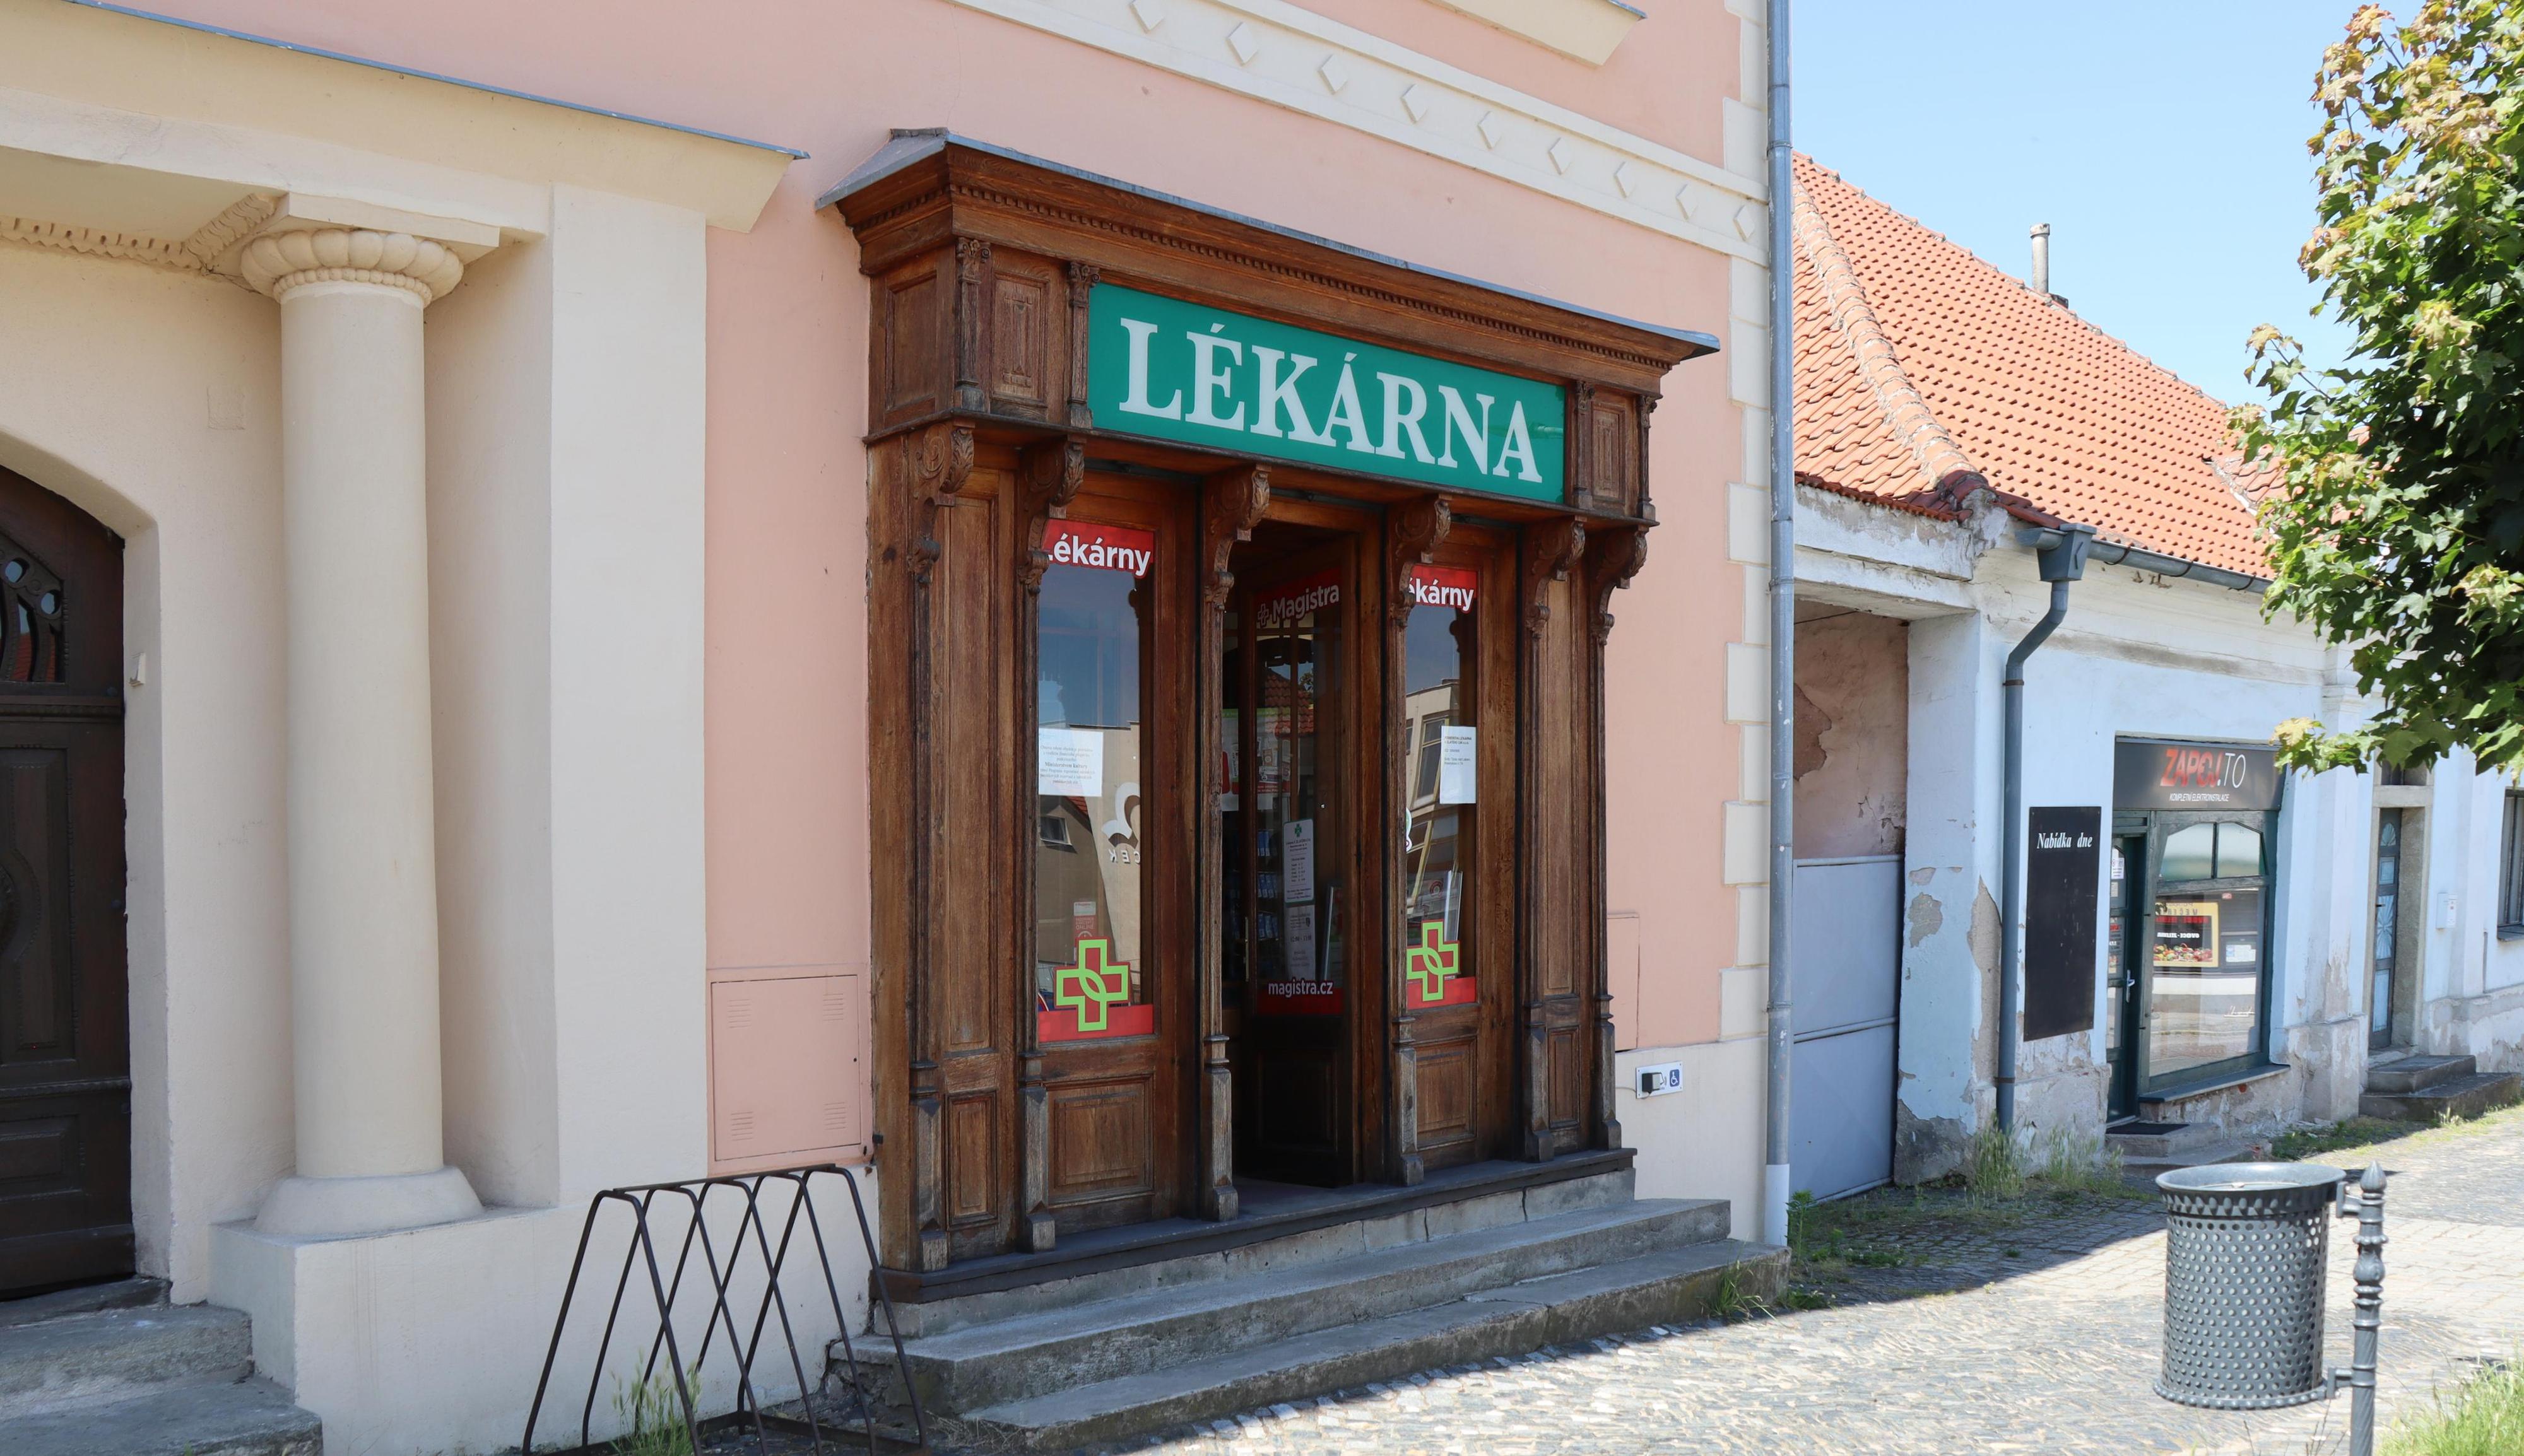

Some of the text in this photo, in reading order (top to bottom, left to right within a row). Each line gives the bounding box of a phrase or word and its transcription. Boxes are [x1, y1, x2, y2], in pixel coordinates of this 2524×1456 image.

[1119, 317, 1543, 484] LÉKÁRNA
[1048, 532, 1151, 576] ékárny
[1272, 584, 1340, 621] Magistra
[2037, 832, 2093, 848] Nabídka dne
[1268, 977, 1333, 998] magistra.cz
